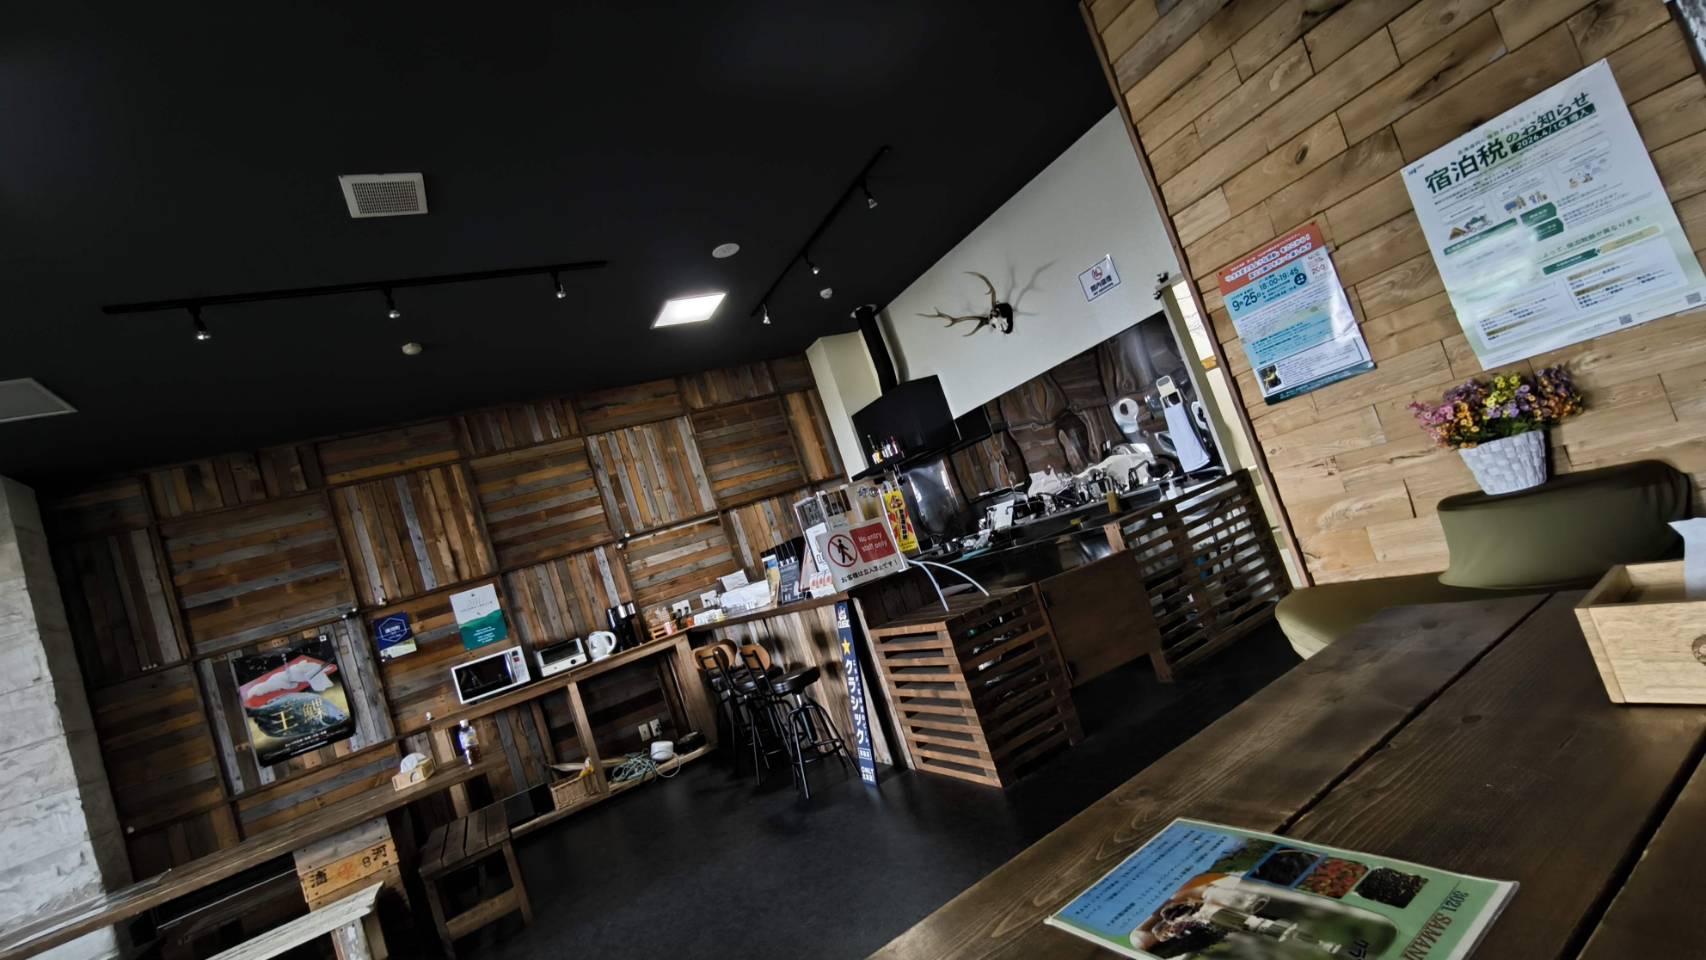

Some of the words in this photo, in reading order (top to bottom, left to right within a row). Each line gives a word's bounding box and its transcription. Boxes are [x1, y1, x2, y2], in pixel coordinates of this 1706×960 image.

[1424, 92, 1590, 193] 宿泊税のお知らせ
[845, 659, 864, 744] クラシック
